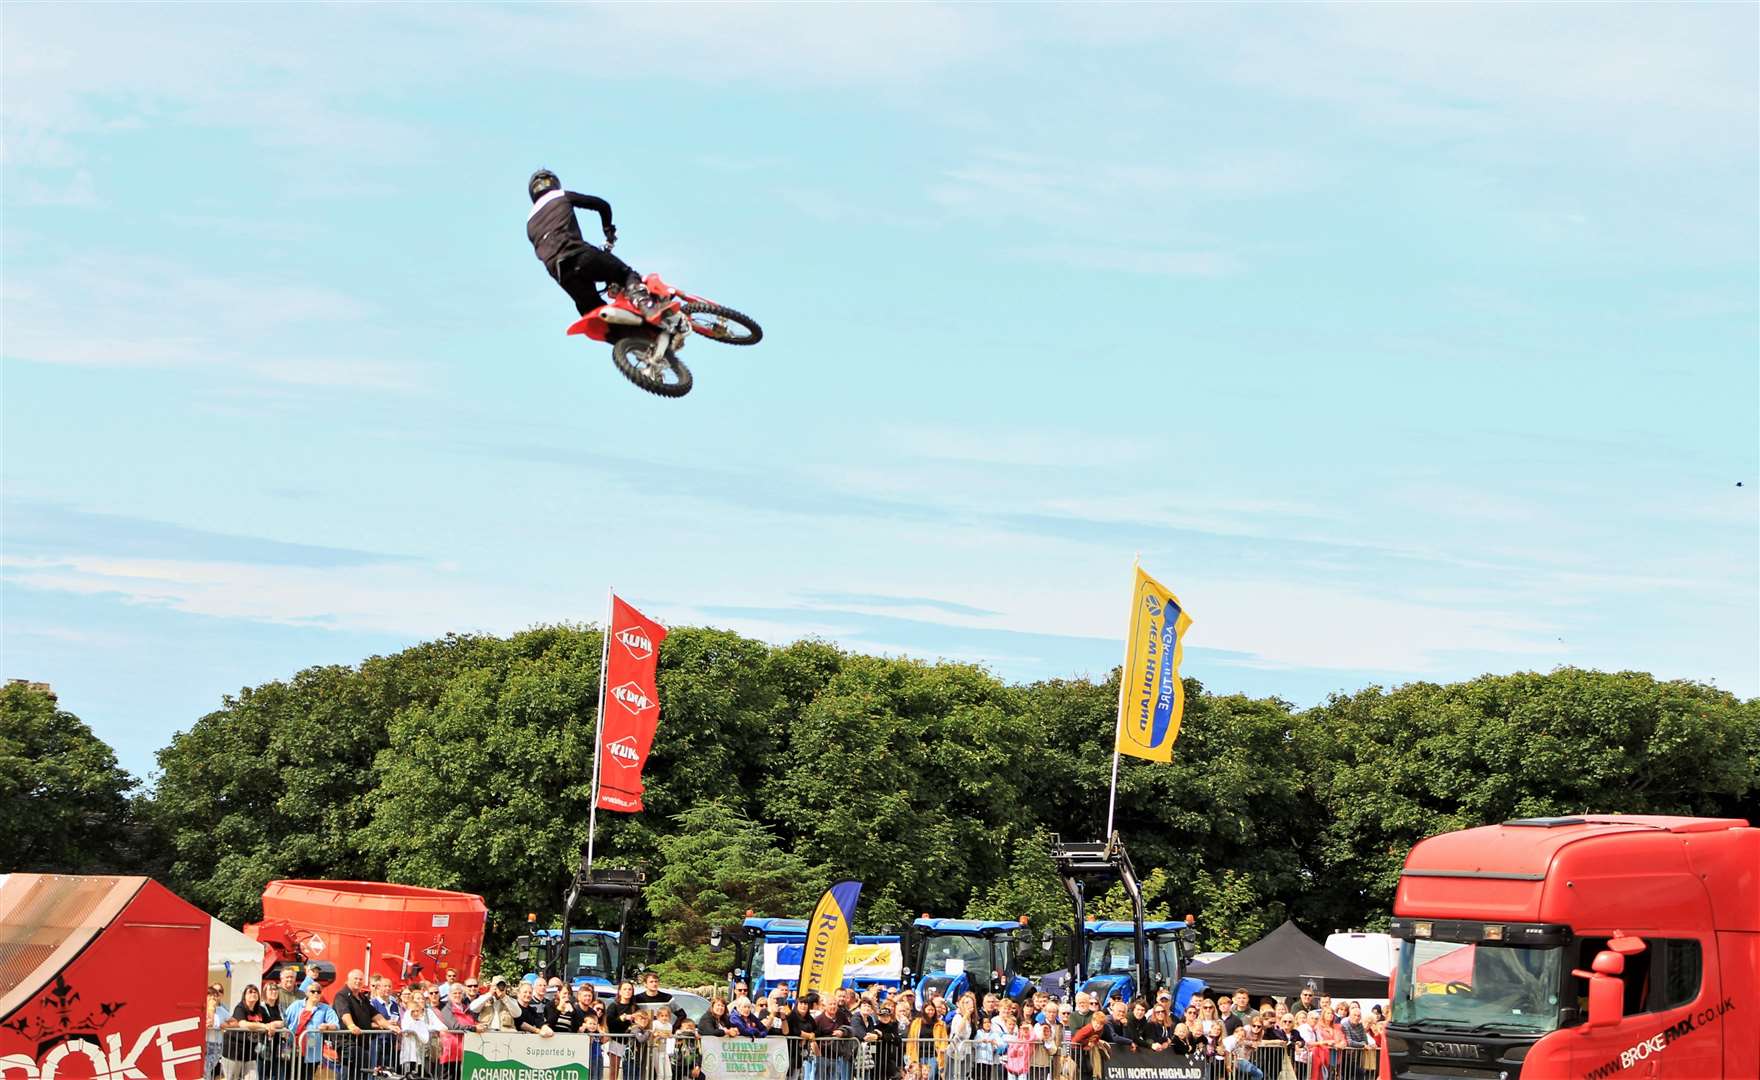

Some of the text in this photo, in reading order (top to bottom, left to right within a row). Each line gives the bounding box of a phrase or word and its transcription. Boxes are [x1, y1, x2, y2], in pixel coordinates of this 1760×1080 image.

[526, 1047, 576, 1057] Supported by
[1421, 1041, 1480, 1059] SCANIA
[471, 1068, 579, 1080] ACHAIRN ENERGY LTD
[1127, 1067, 1157, 1079] NORTH
[1158, 1067, 1202, 1079] HIGHLAND
